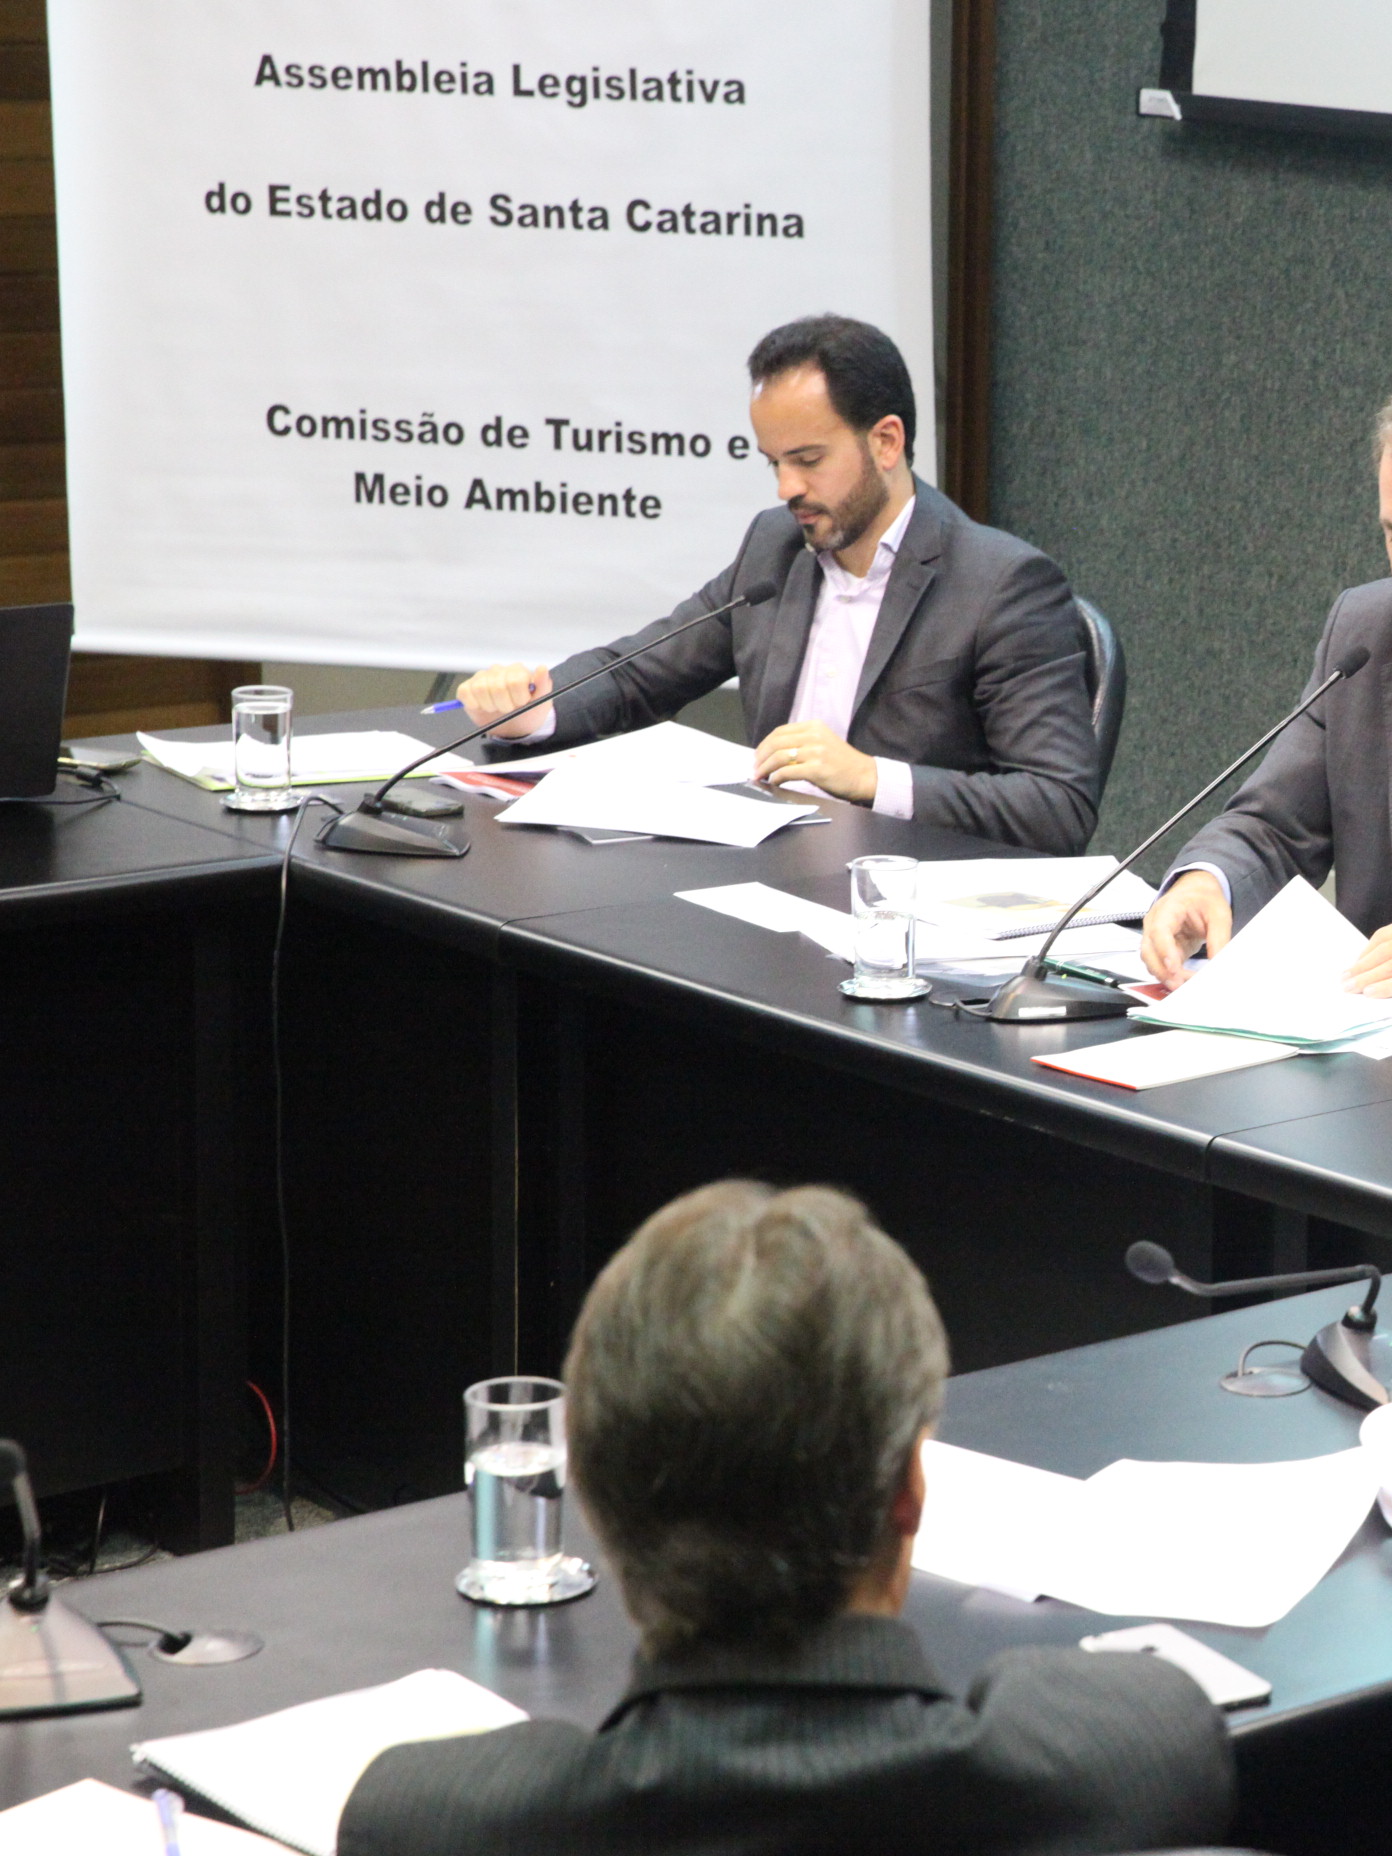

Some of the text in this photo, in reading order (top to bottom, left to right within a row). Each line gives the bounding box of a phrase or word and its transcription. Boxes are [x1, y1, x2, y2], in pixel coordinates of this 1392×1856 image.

[255, 54, 746, 108] Assembleia Legislativa
[204, 182, 805, 239] do Estado de Santa Catarina
[266, 404, 750, 460] Comissão de Turismo e
[354, 472, 663, 519] Meio Ambiente
